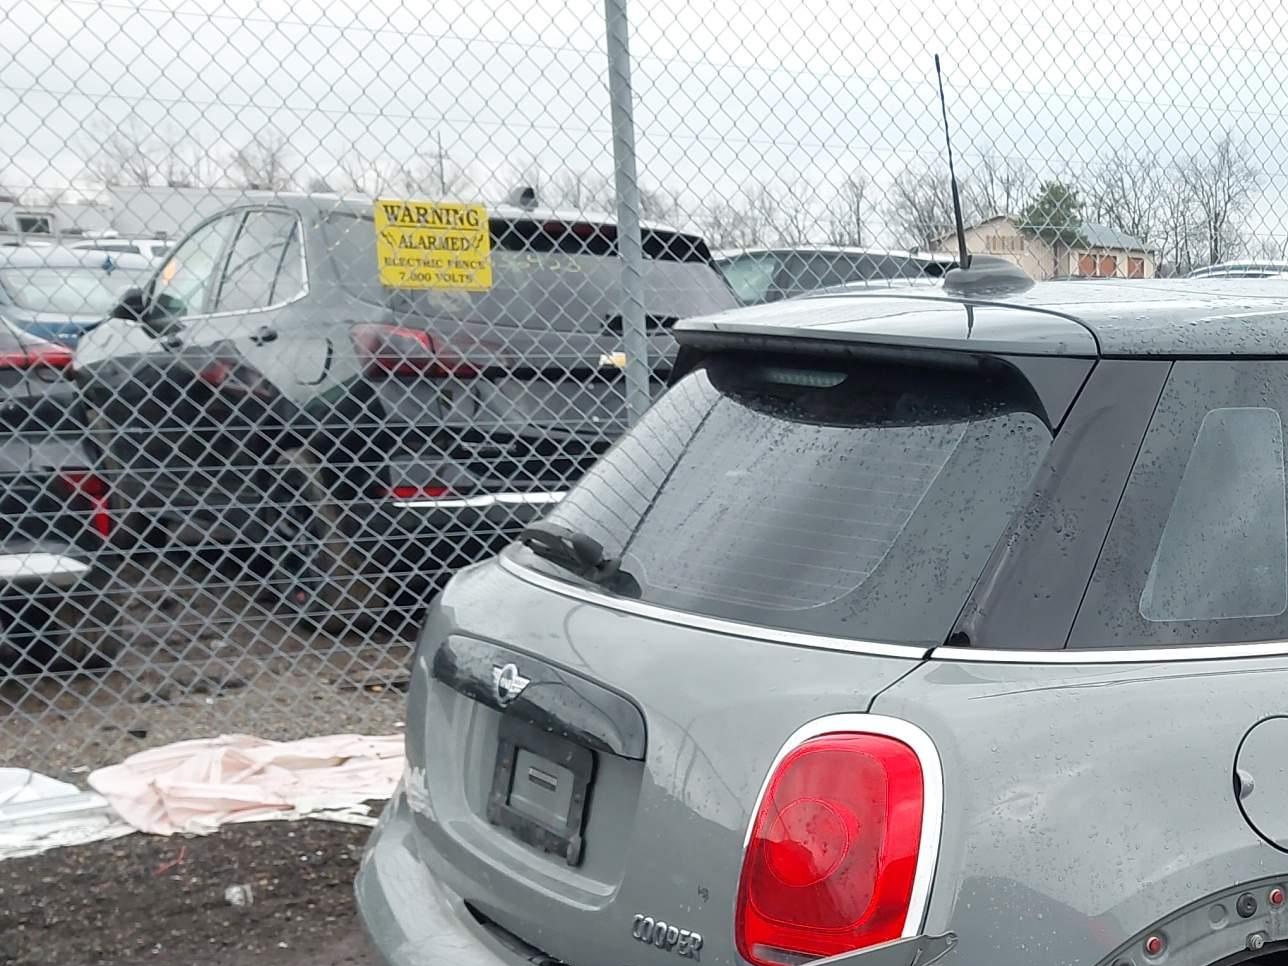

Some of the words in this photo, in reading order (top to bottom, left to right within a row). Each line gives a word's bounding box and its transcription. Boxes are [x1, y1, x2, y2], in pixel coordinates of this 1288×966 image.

[382, 204, 480, 227] WARNING
[398, 235, 470, 252] ALARMED
[384, 256, 445, 269] ELECTRIC
[447, 258, 486, 270] FENCE
[435, 271, 473, 283] VOLTS
[632, 913, 703, 962] COOPER
